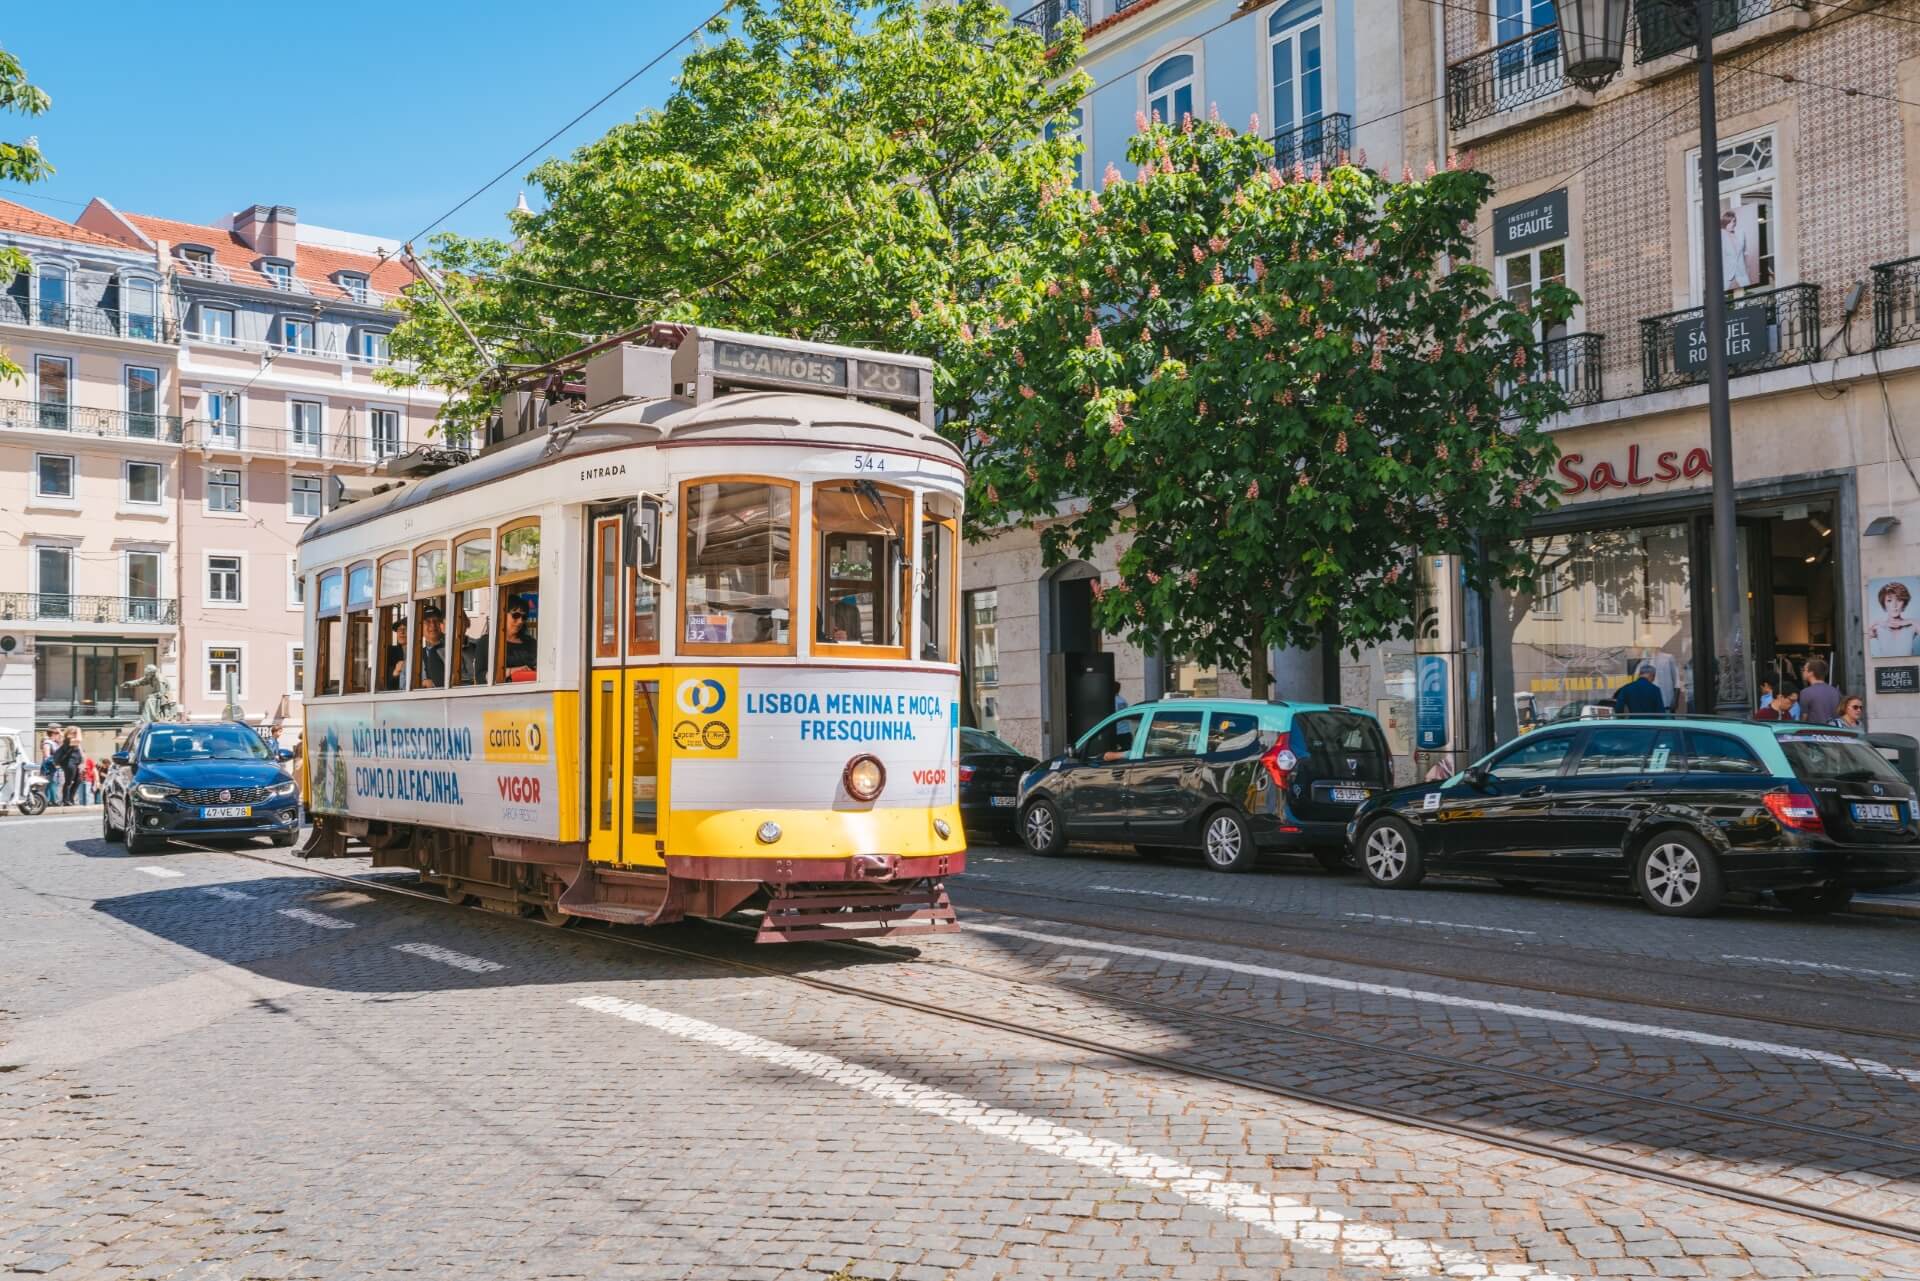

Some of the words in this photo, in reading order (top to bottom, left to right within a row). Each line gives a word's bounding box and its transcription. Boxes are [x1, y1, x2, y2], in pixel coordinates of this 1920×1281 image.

[1508, 209, 1539, 224] INSTITUT
[1509, 211, 1553, 241] BEAUTÉ
[580, 464, 626, 481] ENTRADA
[854, 455, 886, 472] 544
[1557, 443, 1713, 495] Salsa
[689, 630, 705, 640] 32
[746, 693, 821, 715] LISBOA
[826, 694, 893, 716] MENINA
[897, 695, 905, 716] E
[909, 695, 943, 721] MOÇA,
[373, 720, 389, 759] HÁ
[489, 721, 521, 748] carris
[800, 719, 917, 742] FRESQUINHA.
[356, 766, 384, 798] COMO
[387, 767, 395, 798] O
[397, 769, 464, 806] ALFACINHA.
[497, 775, 541, 804] VIGOR
[913, 769, 946, 785] VIGOR
